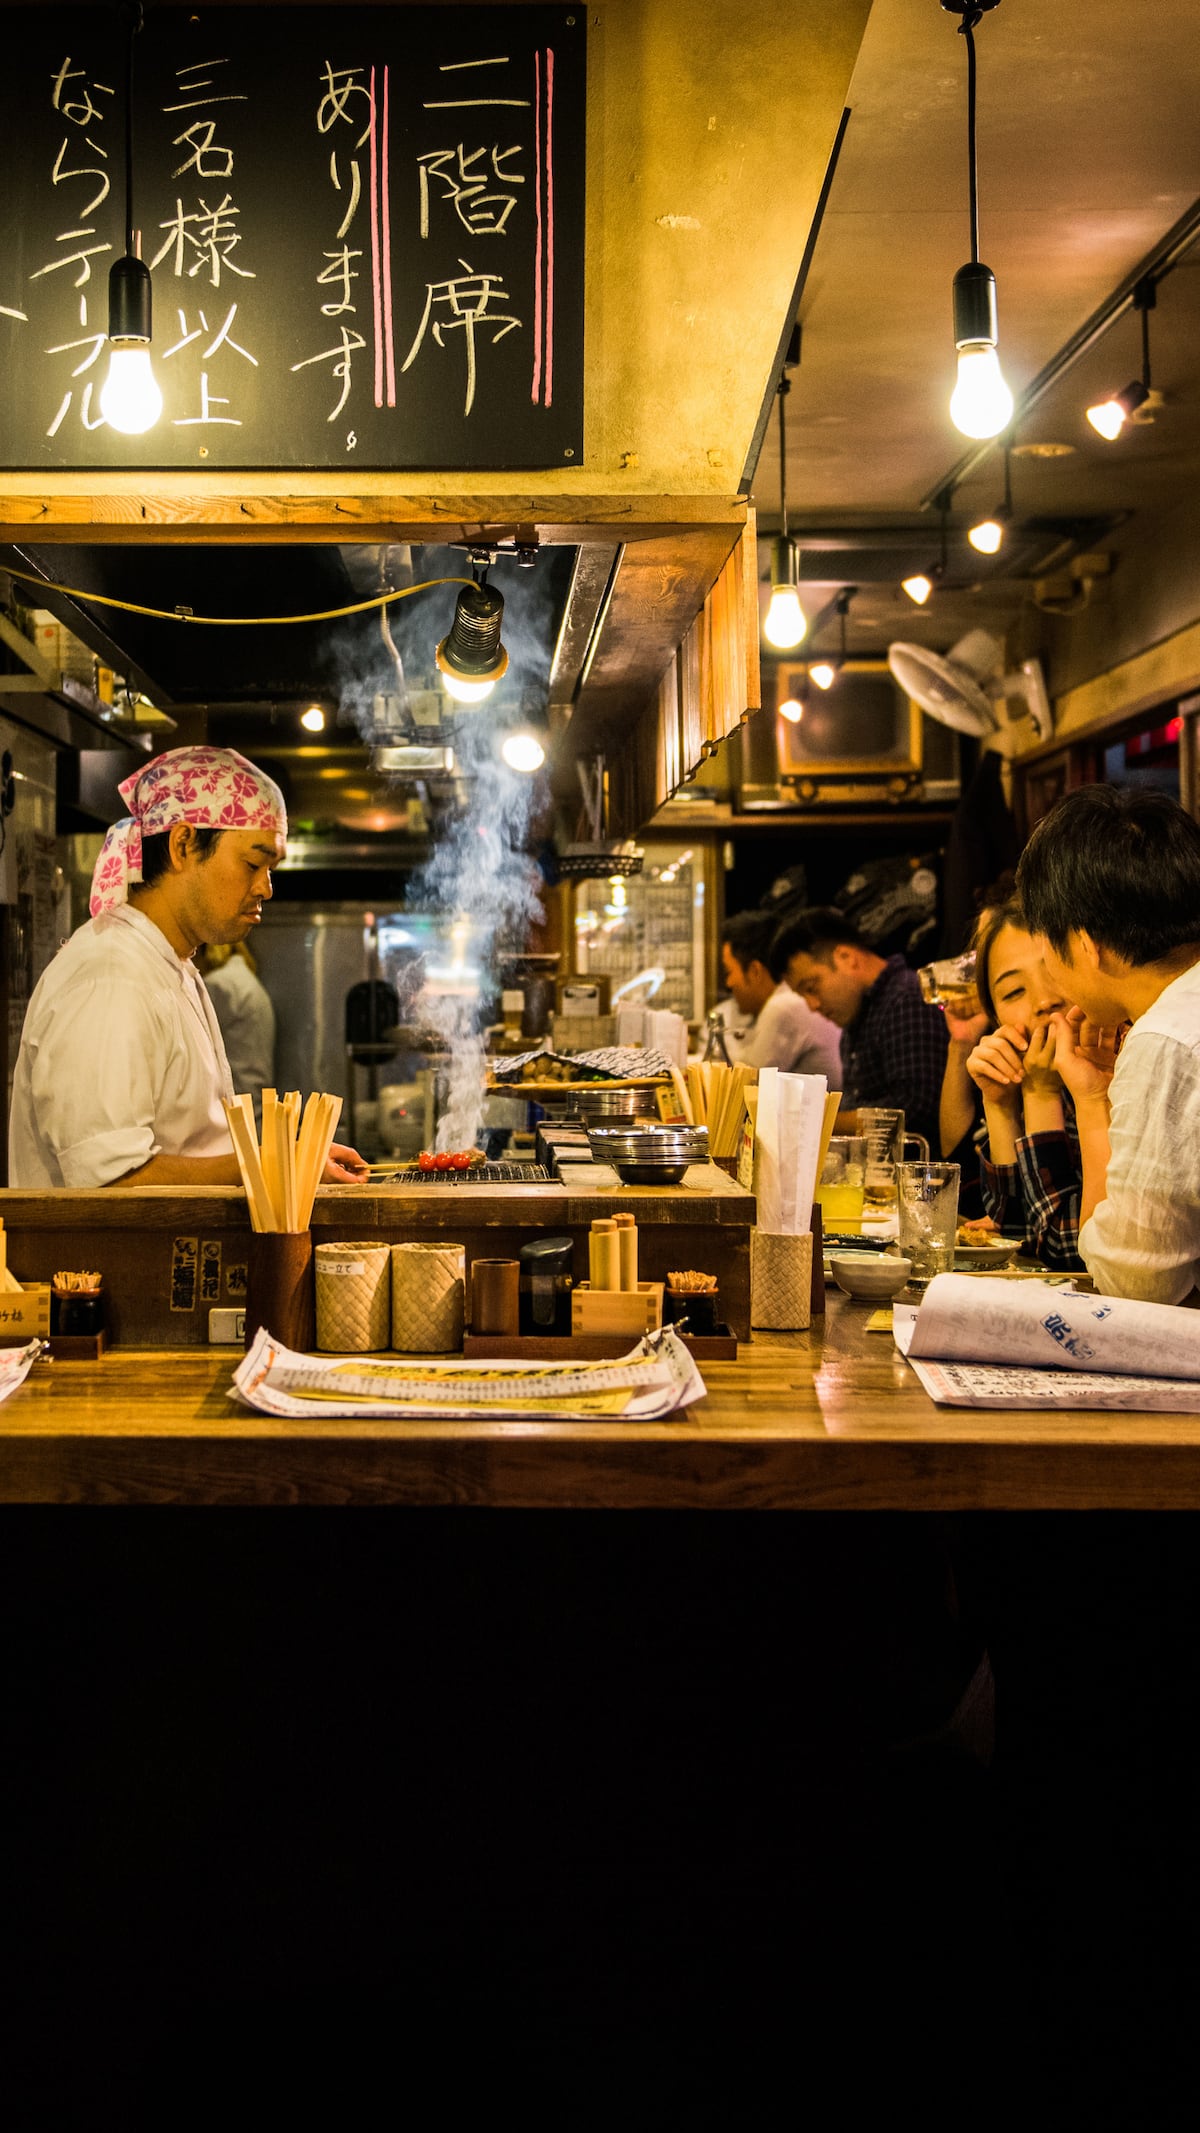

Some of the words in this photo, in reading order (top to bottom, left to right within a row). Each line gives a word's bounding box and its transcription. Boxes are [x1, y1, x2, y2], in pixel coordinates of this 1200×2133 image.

[149, 57, 260, 428] 三名様以上
[401, 56, 532, 417] 二階席
